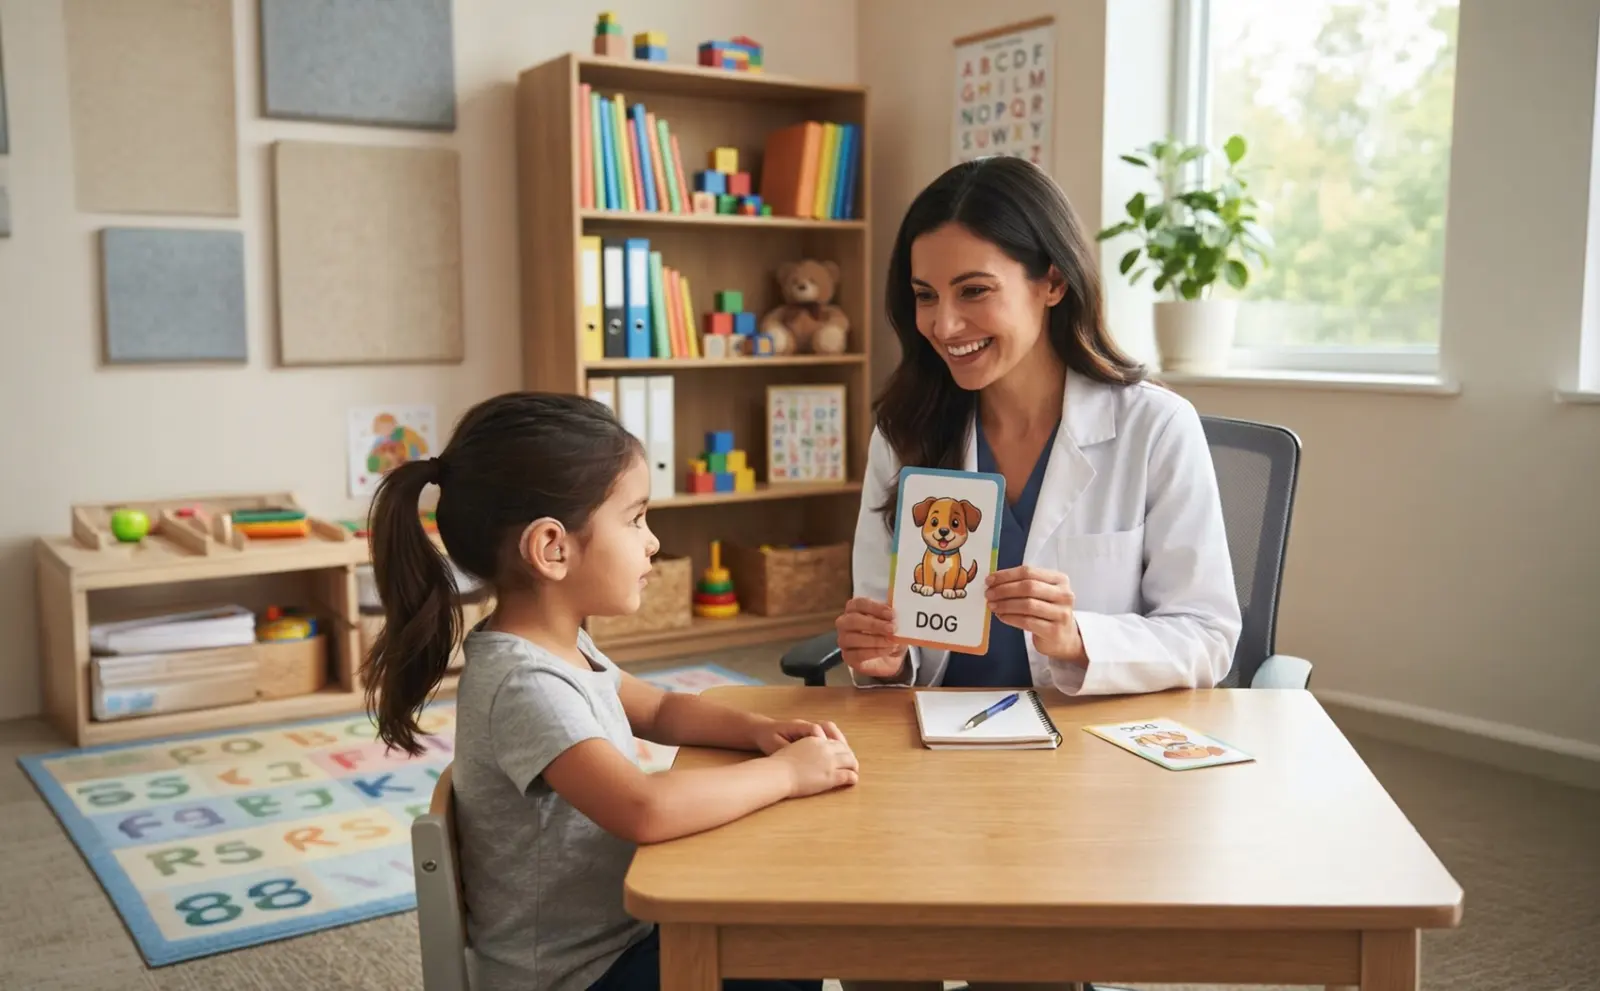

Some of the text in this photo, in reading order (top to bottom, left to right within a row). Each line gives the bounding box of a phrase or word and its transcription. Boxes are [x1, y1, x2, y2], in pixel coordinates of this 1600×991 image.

[995, 52, 1009, 72] C
[1013, 48, 1027, 69] D
[916, 611, 958, 632] DOG
